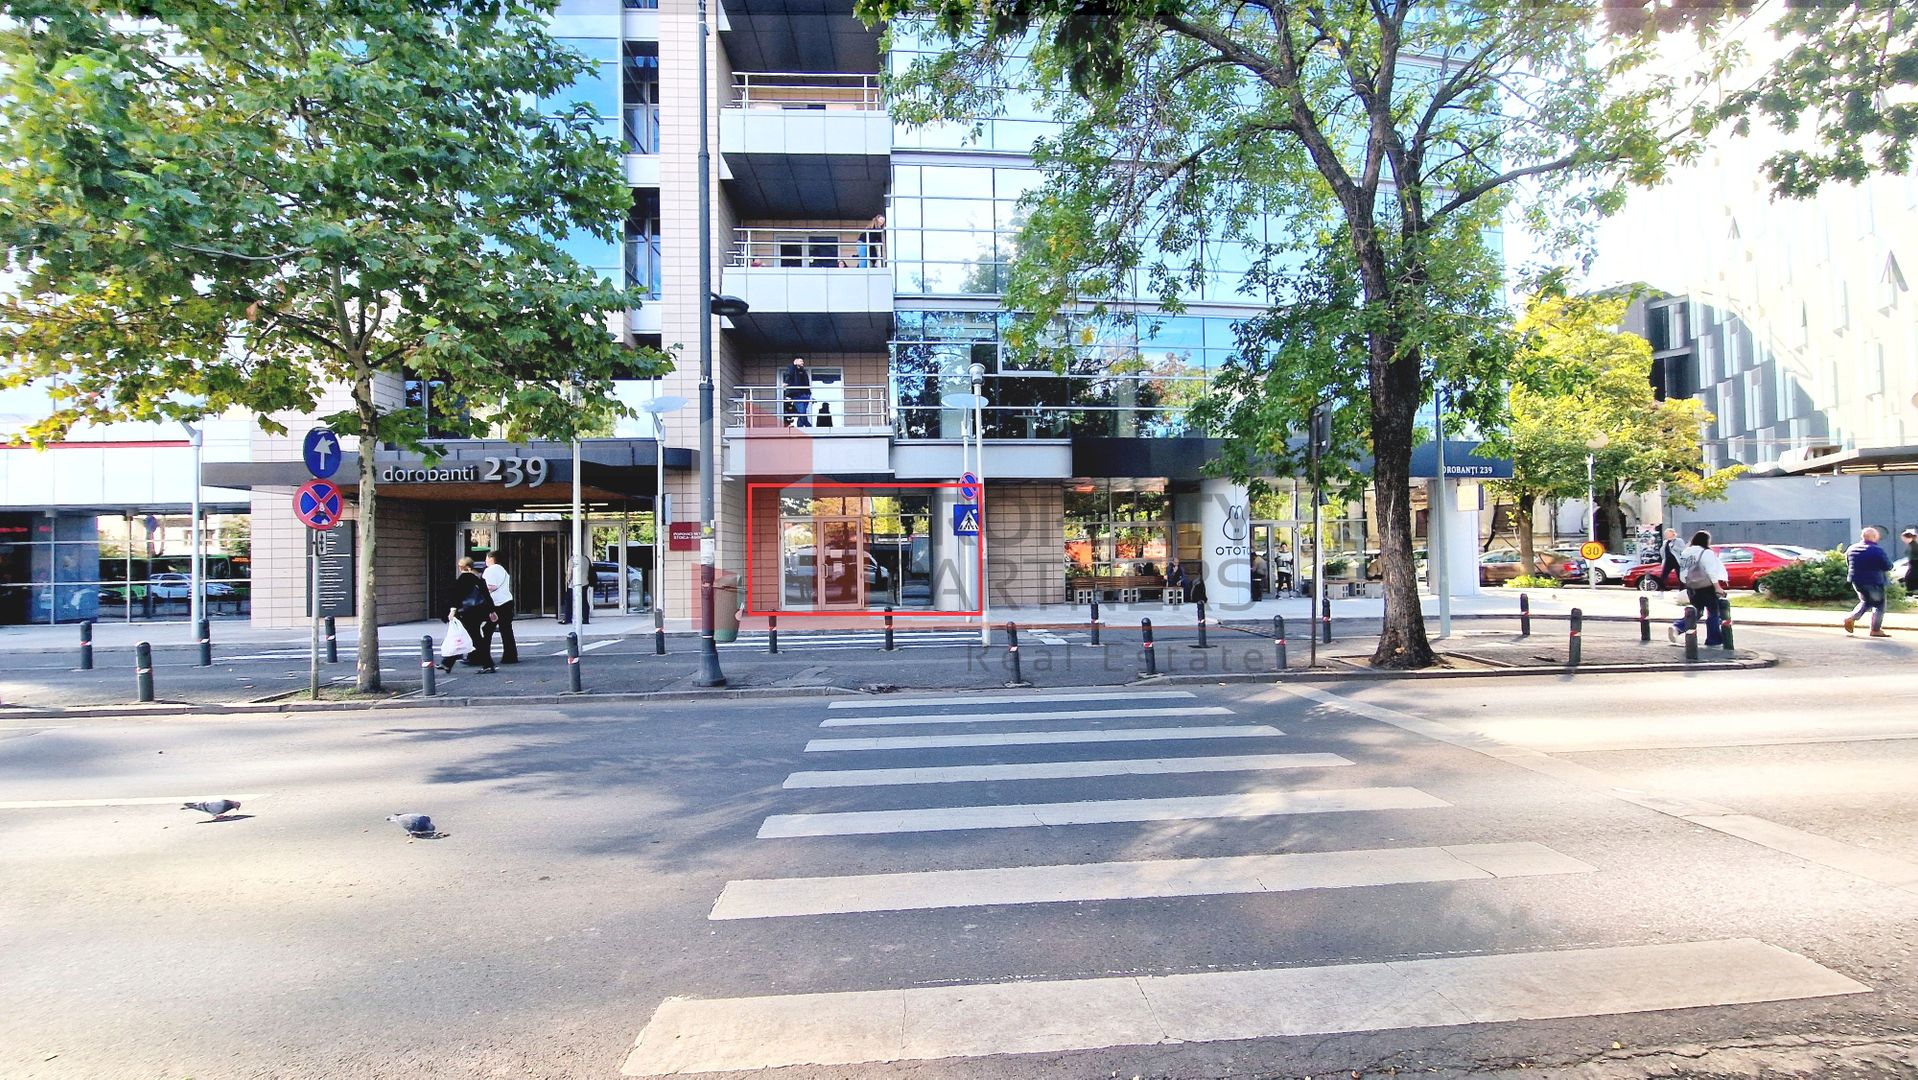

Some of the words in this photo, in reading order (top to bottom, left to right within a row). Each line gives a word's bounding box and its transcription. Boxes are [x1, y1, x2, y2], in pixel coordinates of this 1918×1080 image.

[484, 456, 548, 488] 239
[1480, 466, 1493, 474] 239
[1585, 546, 1600, 555] 30
